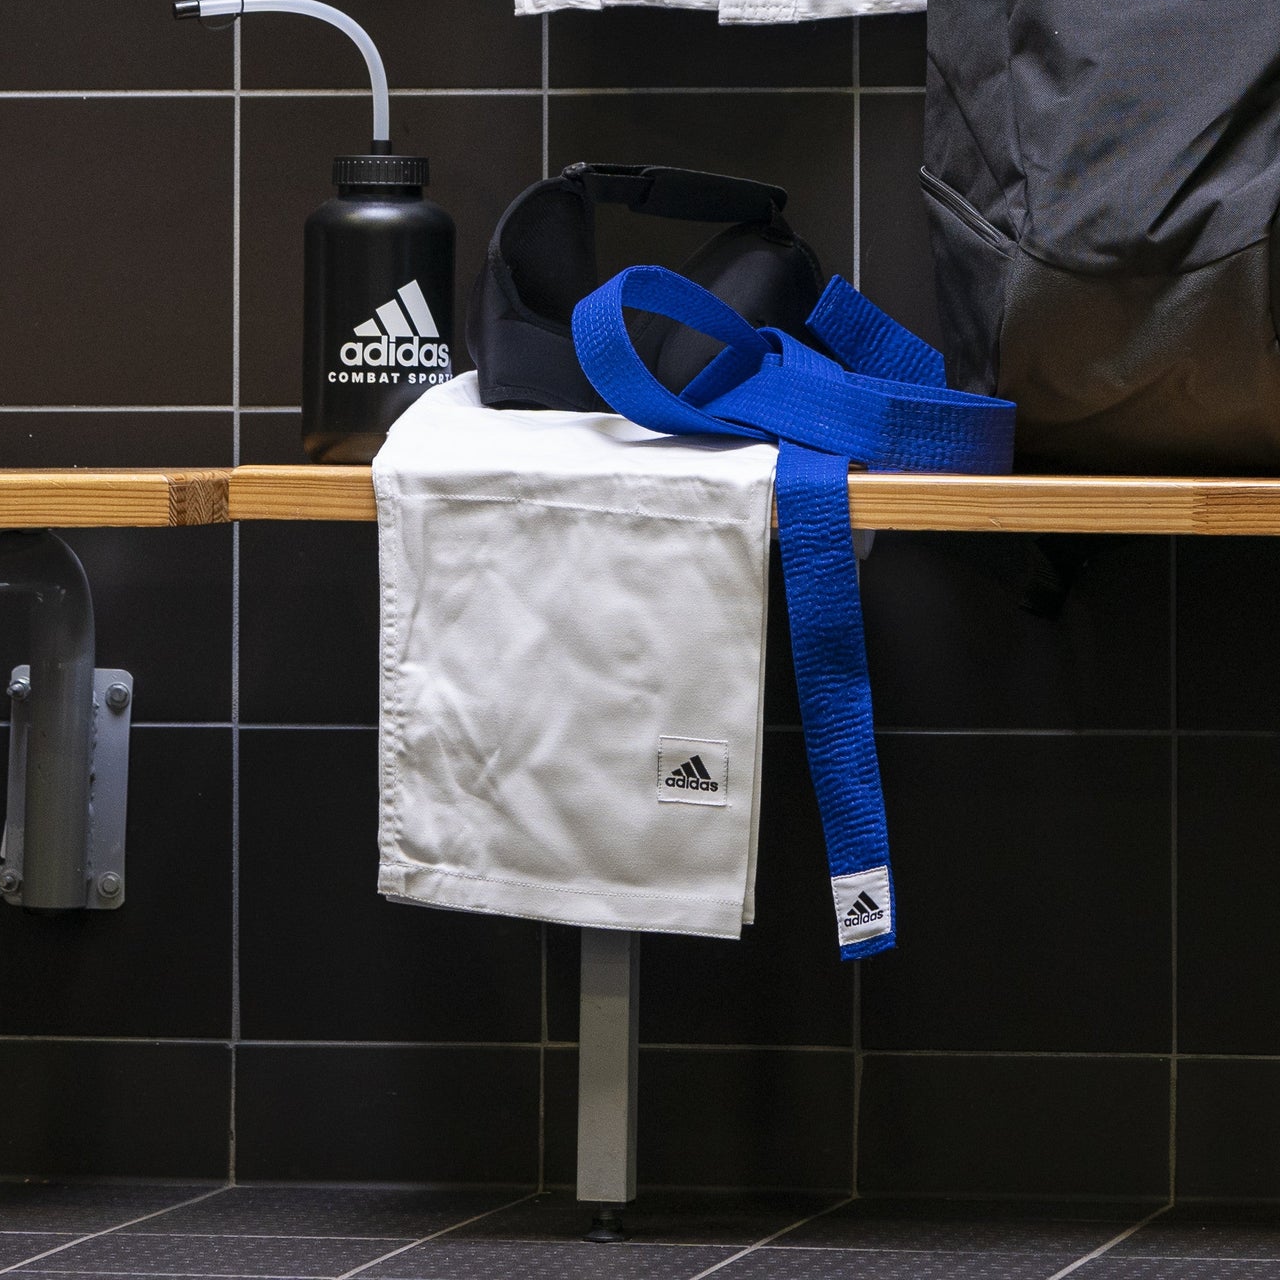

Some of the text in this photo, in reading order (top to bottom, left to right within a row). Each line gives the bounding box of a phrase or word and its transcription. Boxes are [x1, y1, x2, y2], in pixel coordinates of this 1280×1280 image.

[340, 335, 449, 367] adidas
[328, 372, 400, 384] COMBAT
[665, 776, 719, 792] adidas
[843, 909, 884, 927] adidas
